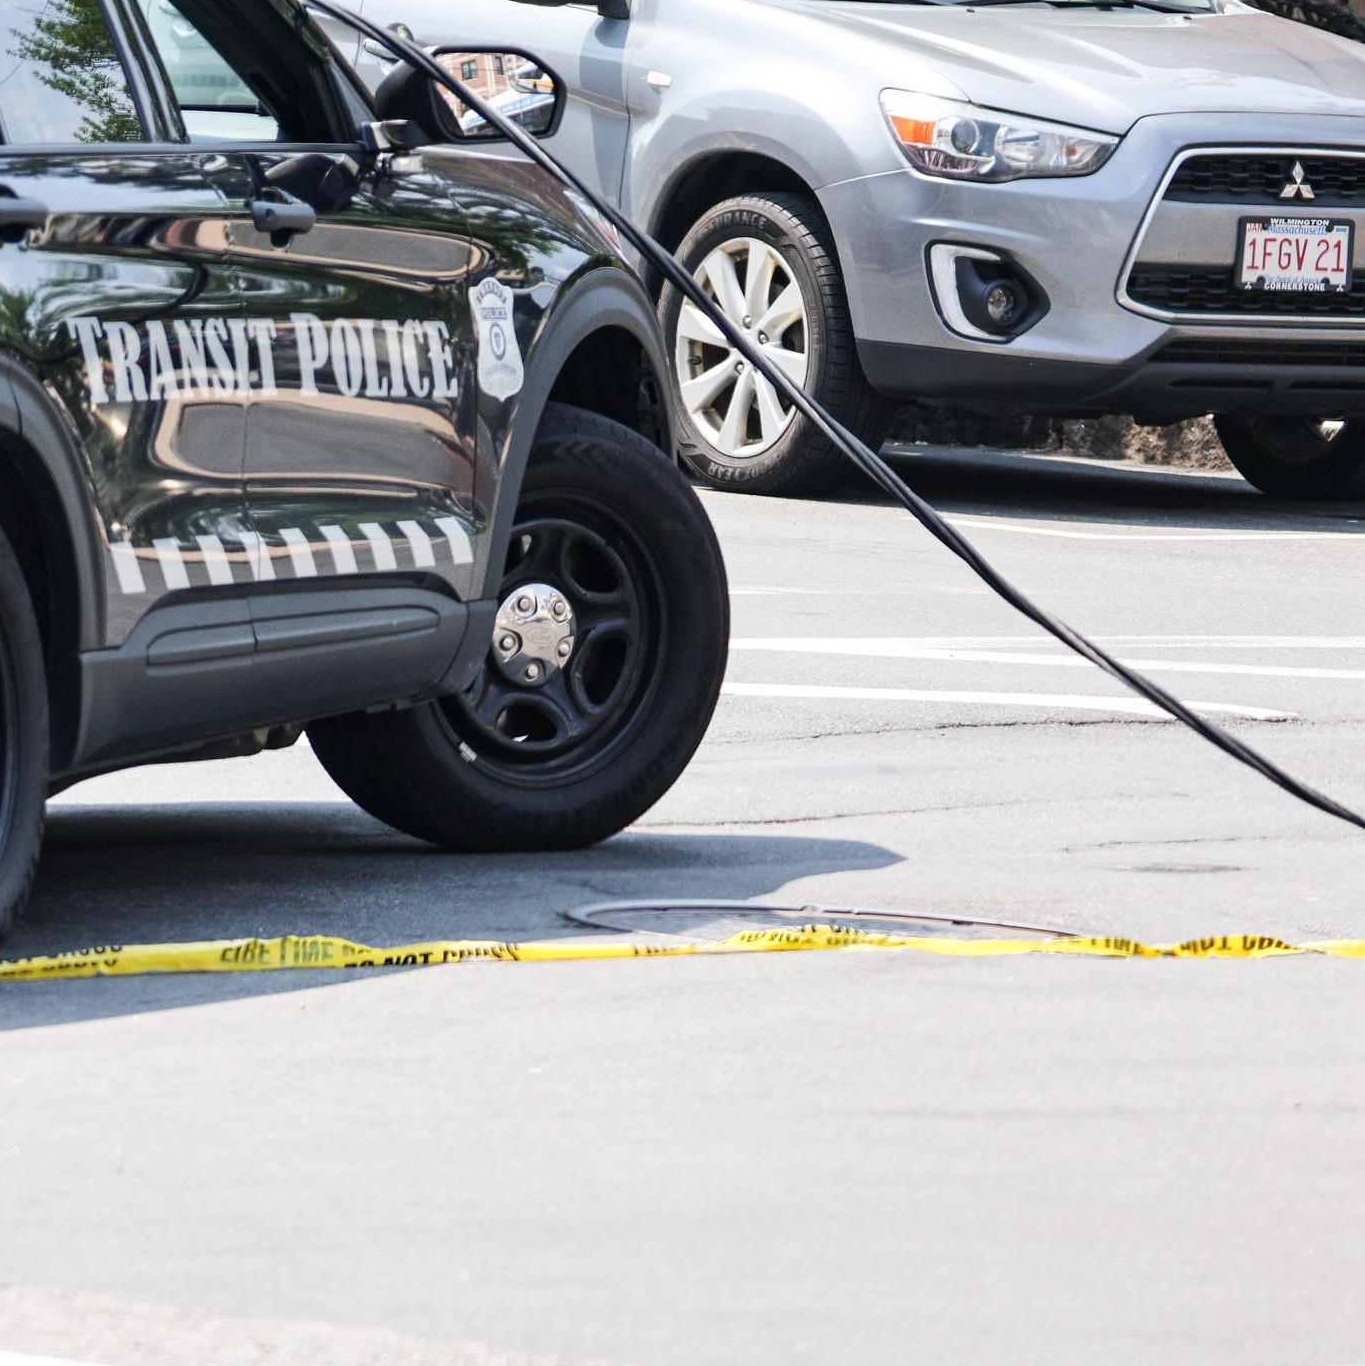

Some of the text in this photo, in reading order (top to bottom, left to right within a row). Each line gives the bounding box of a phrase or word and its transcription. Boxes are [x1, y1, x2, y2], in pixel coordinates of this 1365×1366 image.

[1270, 217, 1330, 226] WILMINGTON
[1246, 223, 1263, 232] JAN
[1246, 237, 1345, 273] 1FGV 21
[1263, 282, 1326, 292] CORNERSTONE
[481, 307, 507, 320] POLICE
[68, 312, 459, 404] TRANSIT POLICE
